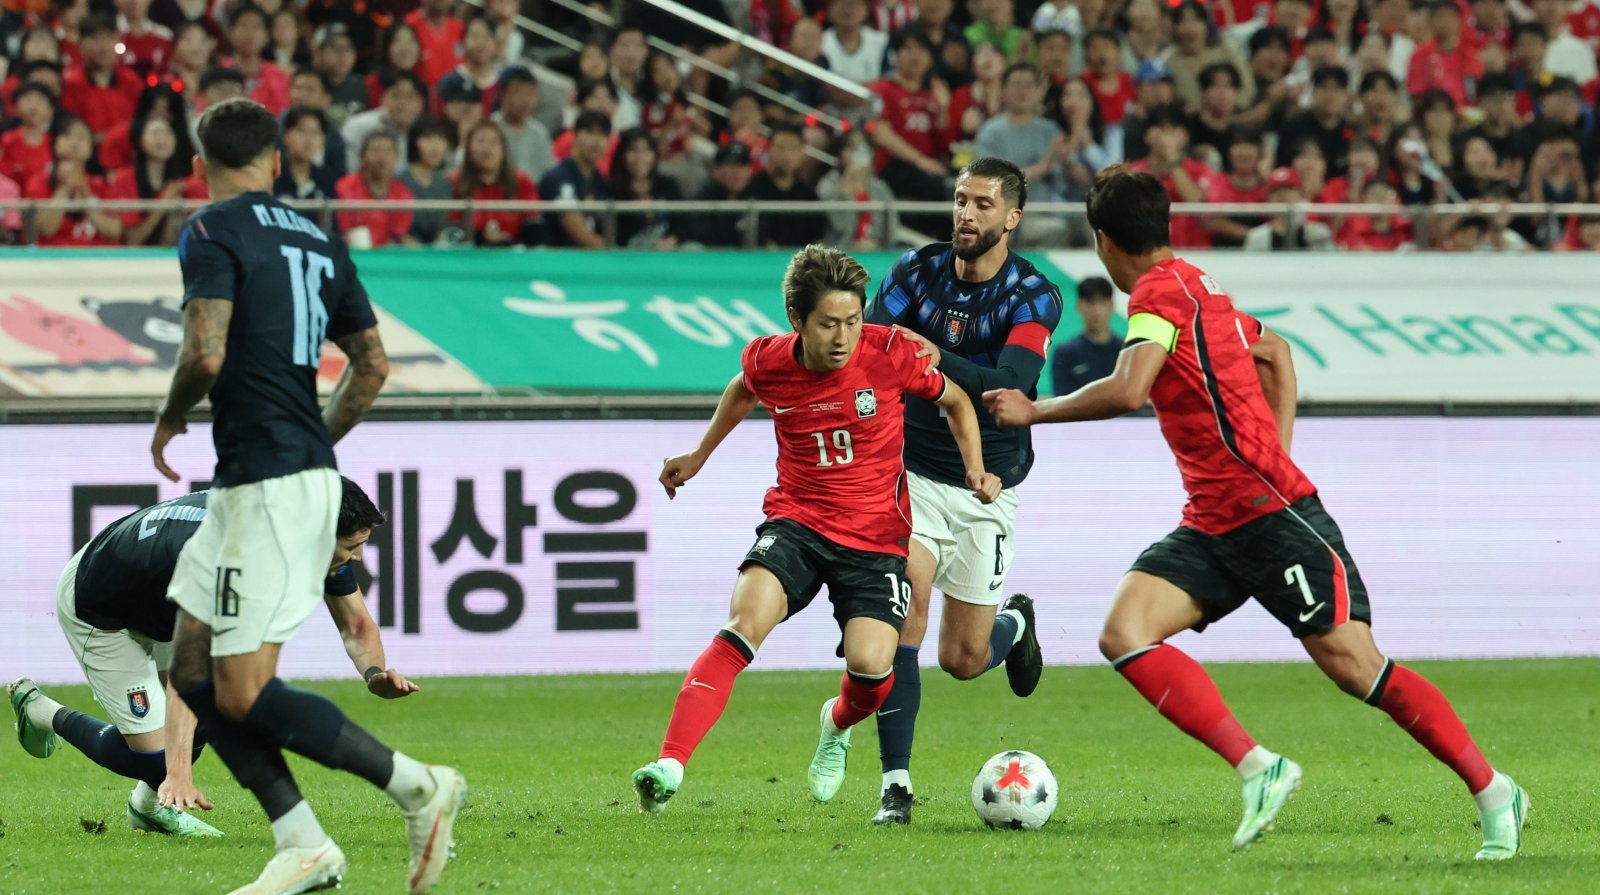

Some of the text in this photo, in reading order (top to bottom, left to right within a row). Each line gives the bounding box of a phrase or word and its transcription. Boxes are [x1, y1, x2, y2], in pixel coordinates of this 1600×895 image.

[280, 244, 335, 368] 16
[811, 430, 854, 467] 19
[215, 566, 242, 617] 16
[884, 572, 912, 618] 19
[1284, 563, 1316, 606] 7
